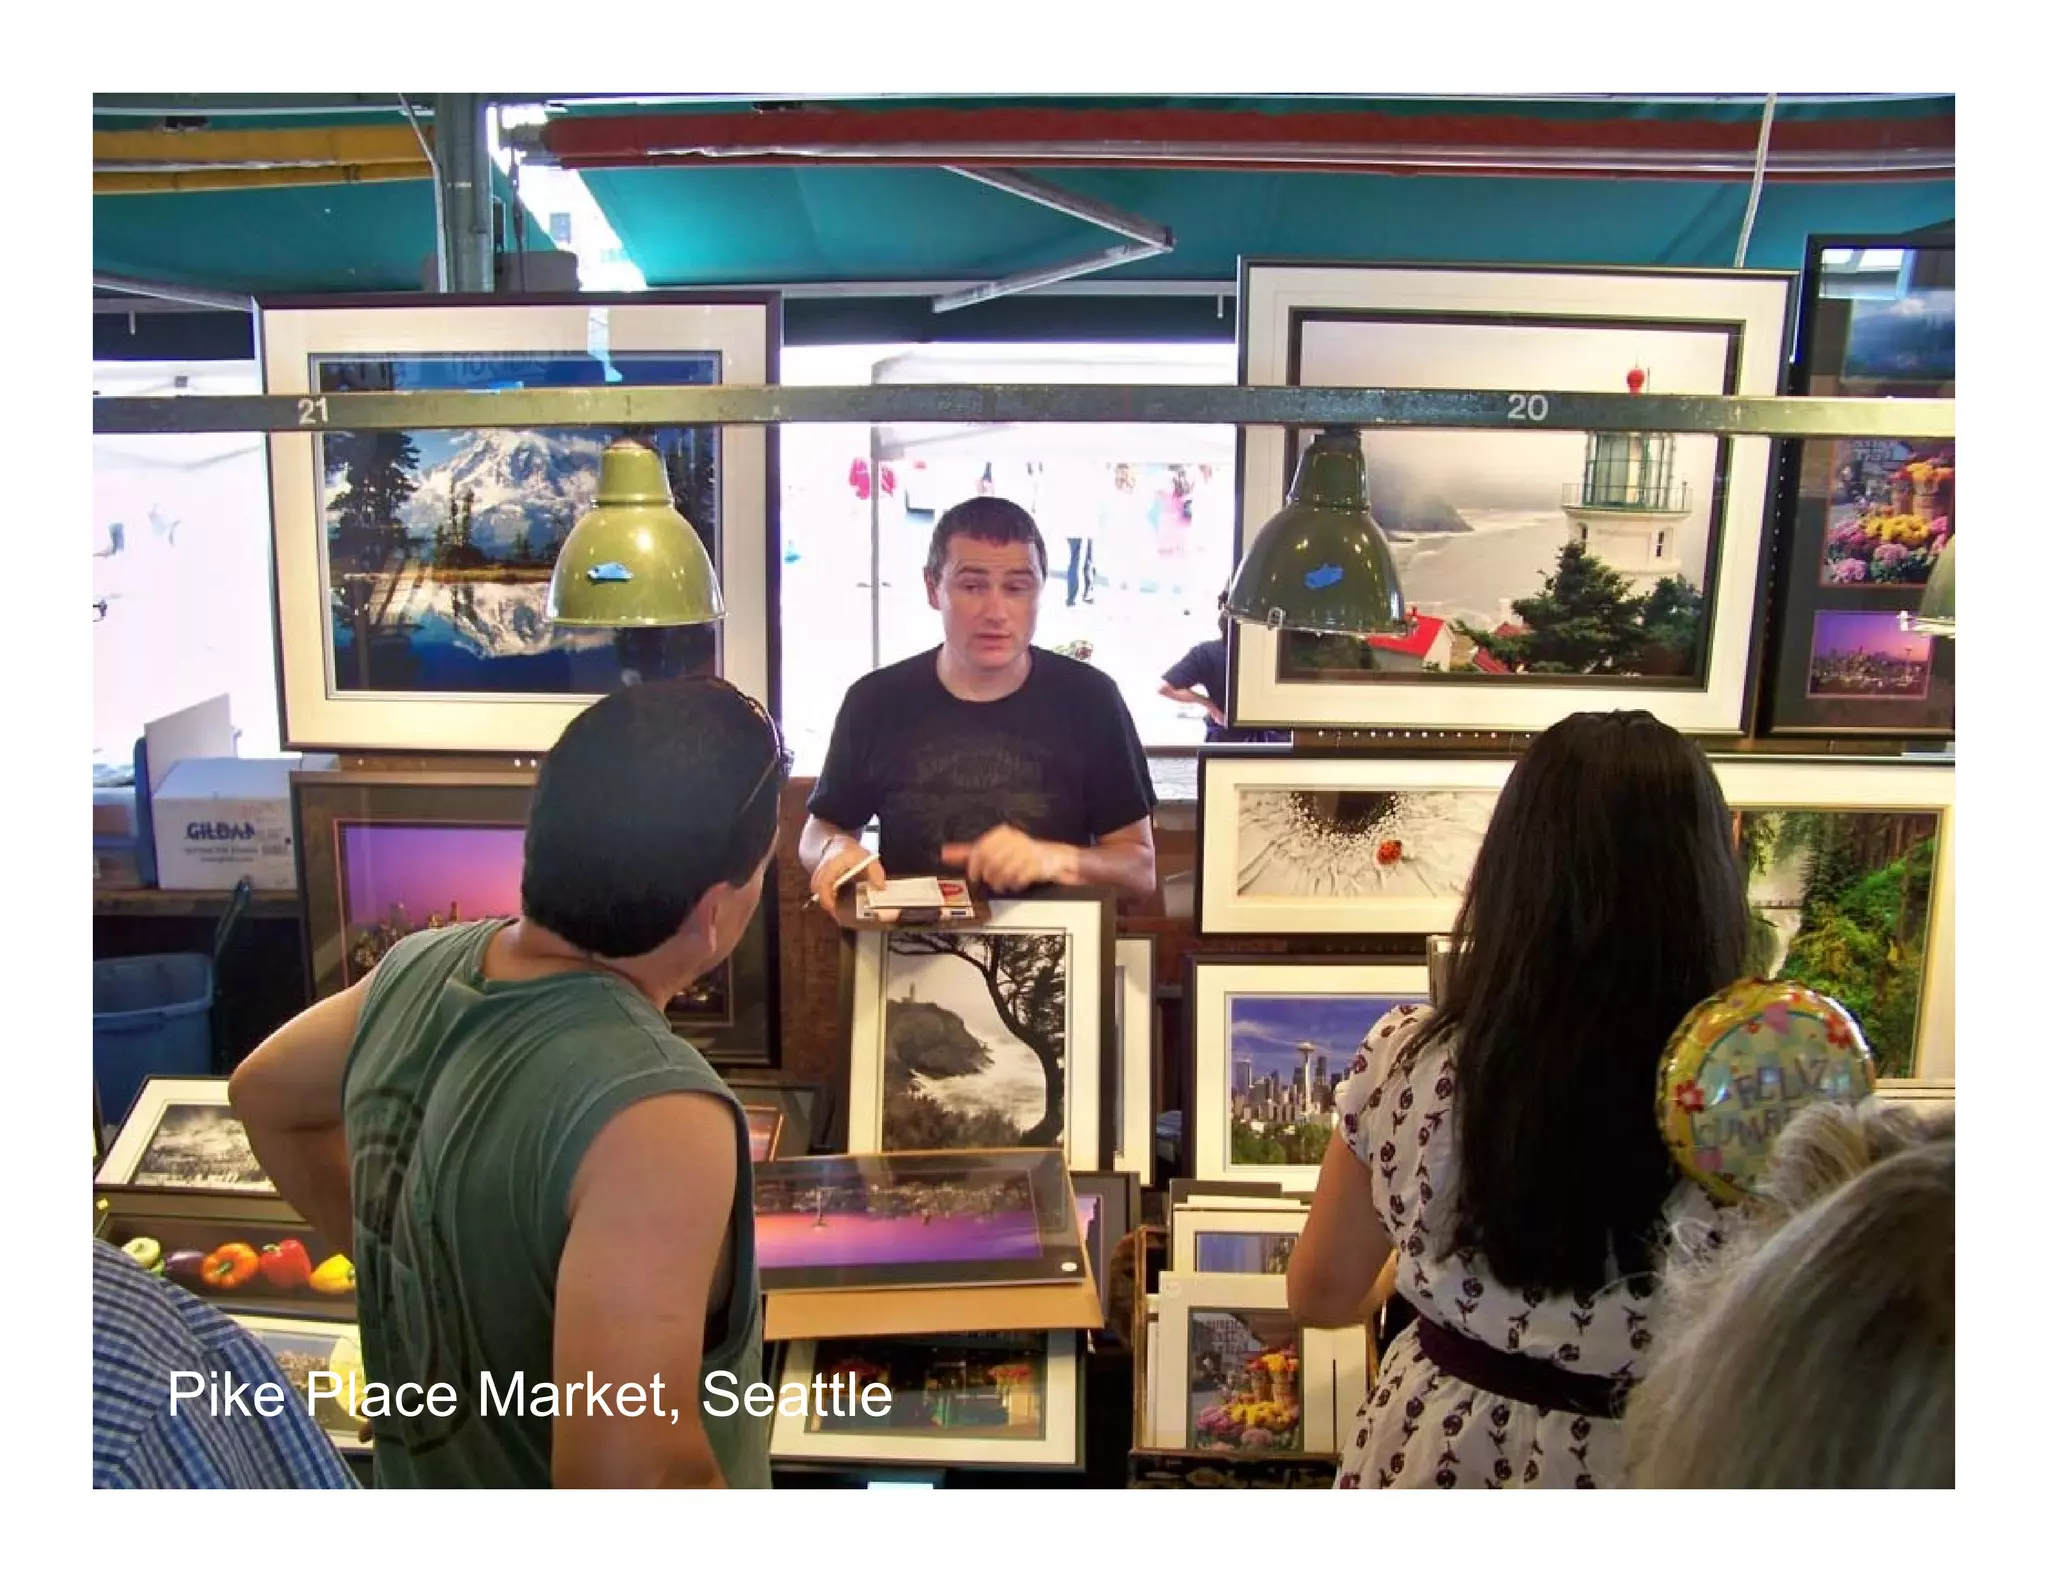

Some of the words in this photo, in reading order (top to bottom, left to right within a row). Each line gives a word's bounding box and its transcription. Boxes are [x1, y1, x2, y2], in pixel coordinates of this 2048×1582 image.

[298, 396, 328, 425] 21
[1507, 394, 1549, 421] 20
[1734, 1057, 1829, 1110] FELIZ
